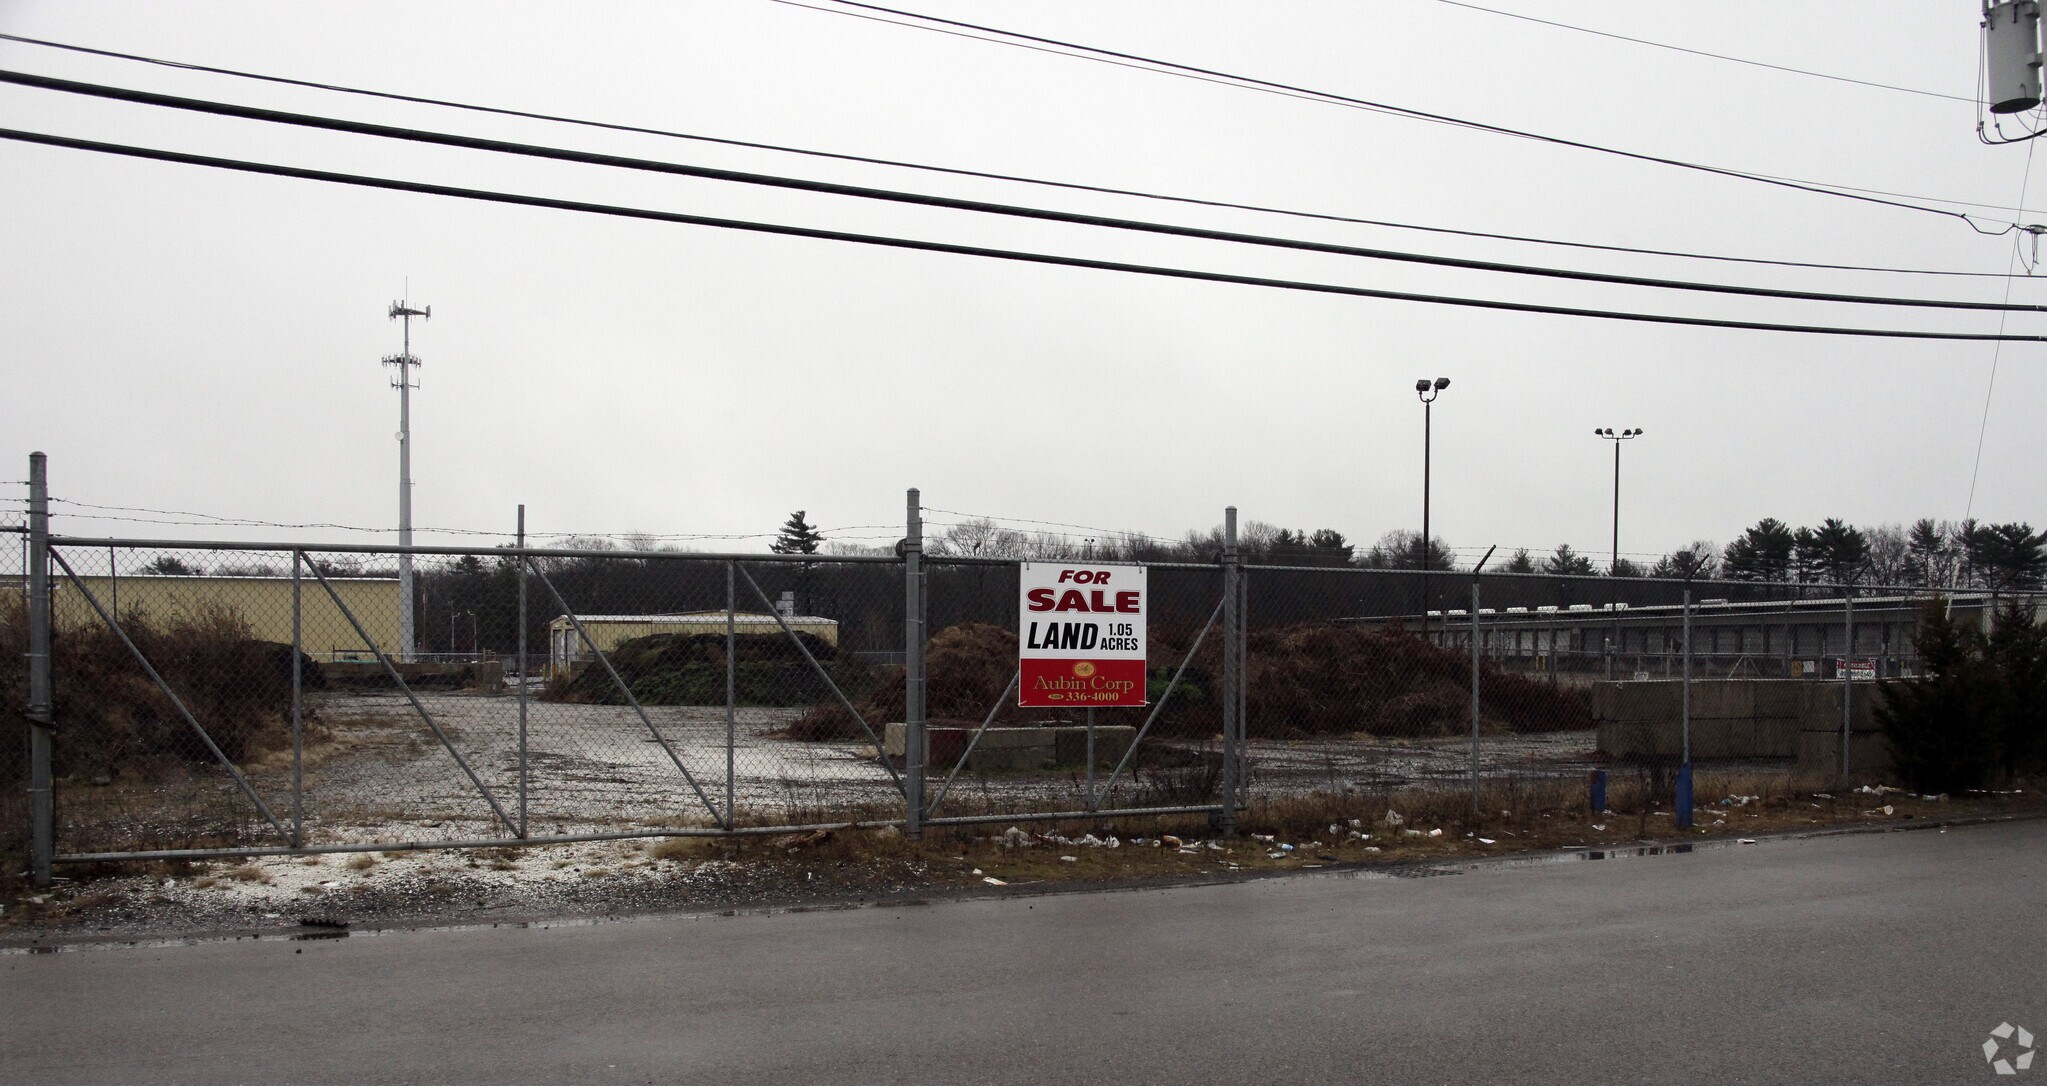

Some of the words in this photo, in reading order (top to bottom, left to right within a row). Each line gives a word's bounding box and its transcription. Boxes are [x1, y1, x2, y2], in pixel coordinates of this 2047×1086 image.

[1058, 570, 1111, 584] FOR
[1027, 588, 1140, 614] SALE
[1027, 622, 1098, 649] LAND
[1109, 623, 1132, 636] 1.05
[1100, 638, 1138, 650] ACRES
[1033, 676, 1086, 690] Aubin
[1090, 676, 1134, 693] Corp
[1066, 692, 1119, 701] 336-4000
